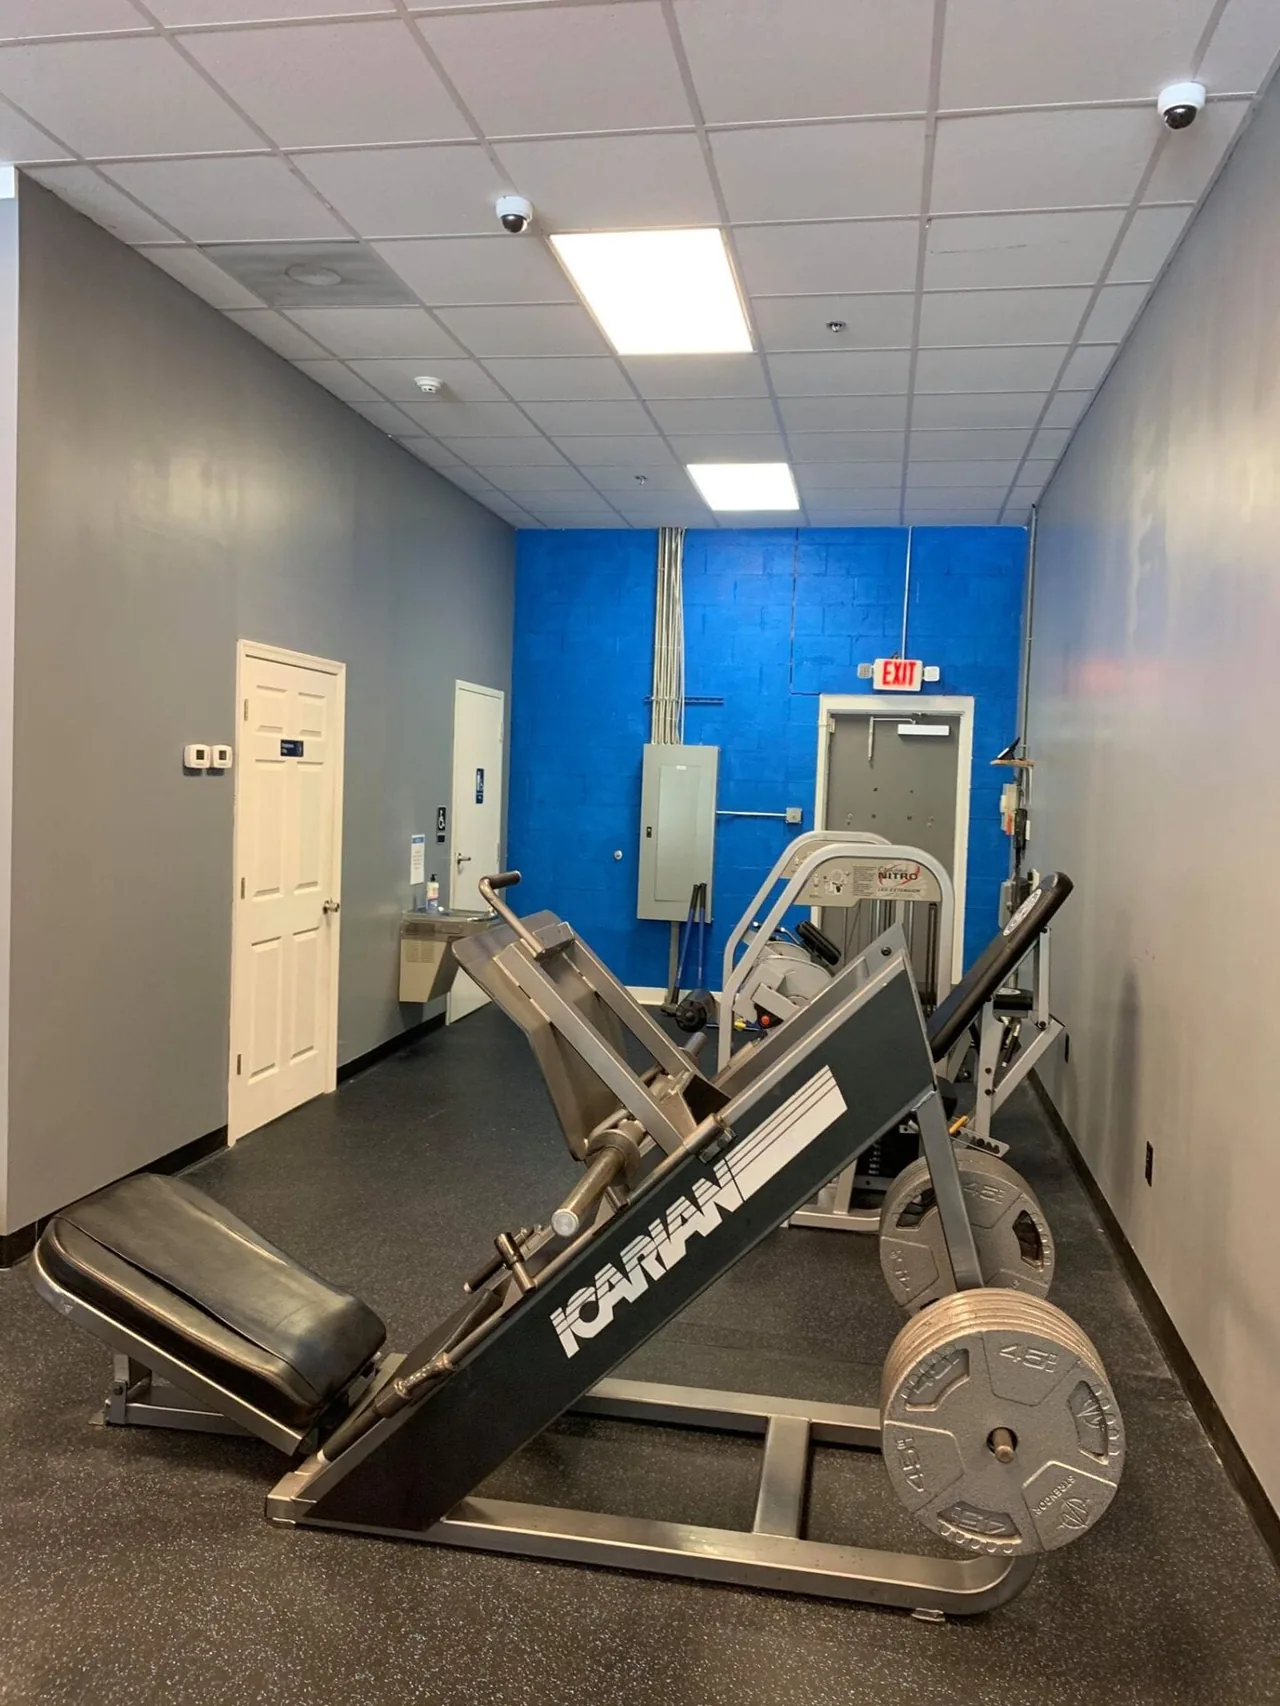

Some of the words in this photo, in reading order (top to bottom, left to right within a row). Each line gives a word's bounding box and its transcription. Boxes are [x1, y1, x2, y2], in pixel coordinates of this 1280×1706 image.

[882, 660, 917, 686] EXIT
[878, 872, 918, 881] NITRO
[550, 1158, 745, 1360] ICARIAN
